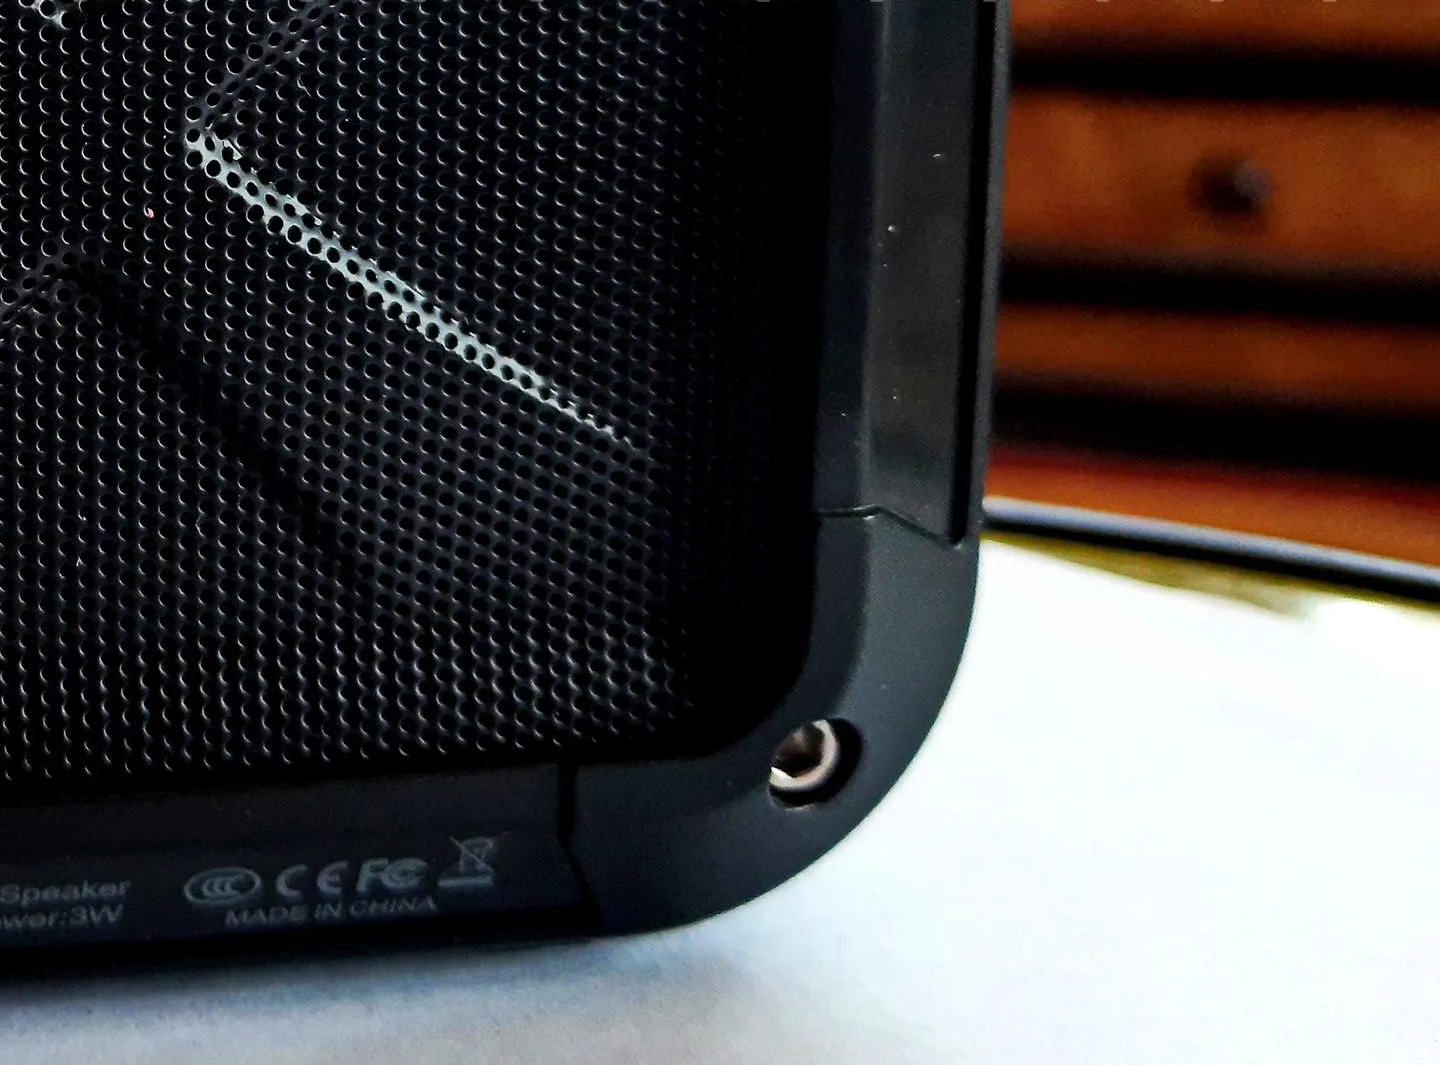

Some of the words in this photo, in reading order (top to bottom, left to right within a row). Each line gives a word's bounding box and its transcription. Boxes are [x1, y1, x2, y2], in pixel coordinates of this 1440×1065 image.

[0, 880, 133, 907] Speaker
[224, 904, 307, 929] MADE
[314, 902, 344, 921] IN
[348, 893, 439, 917] CHINA
